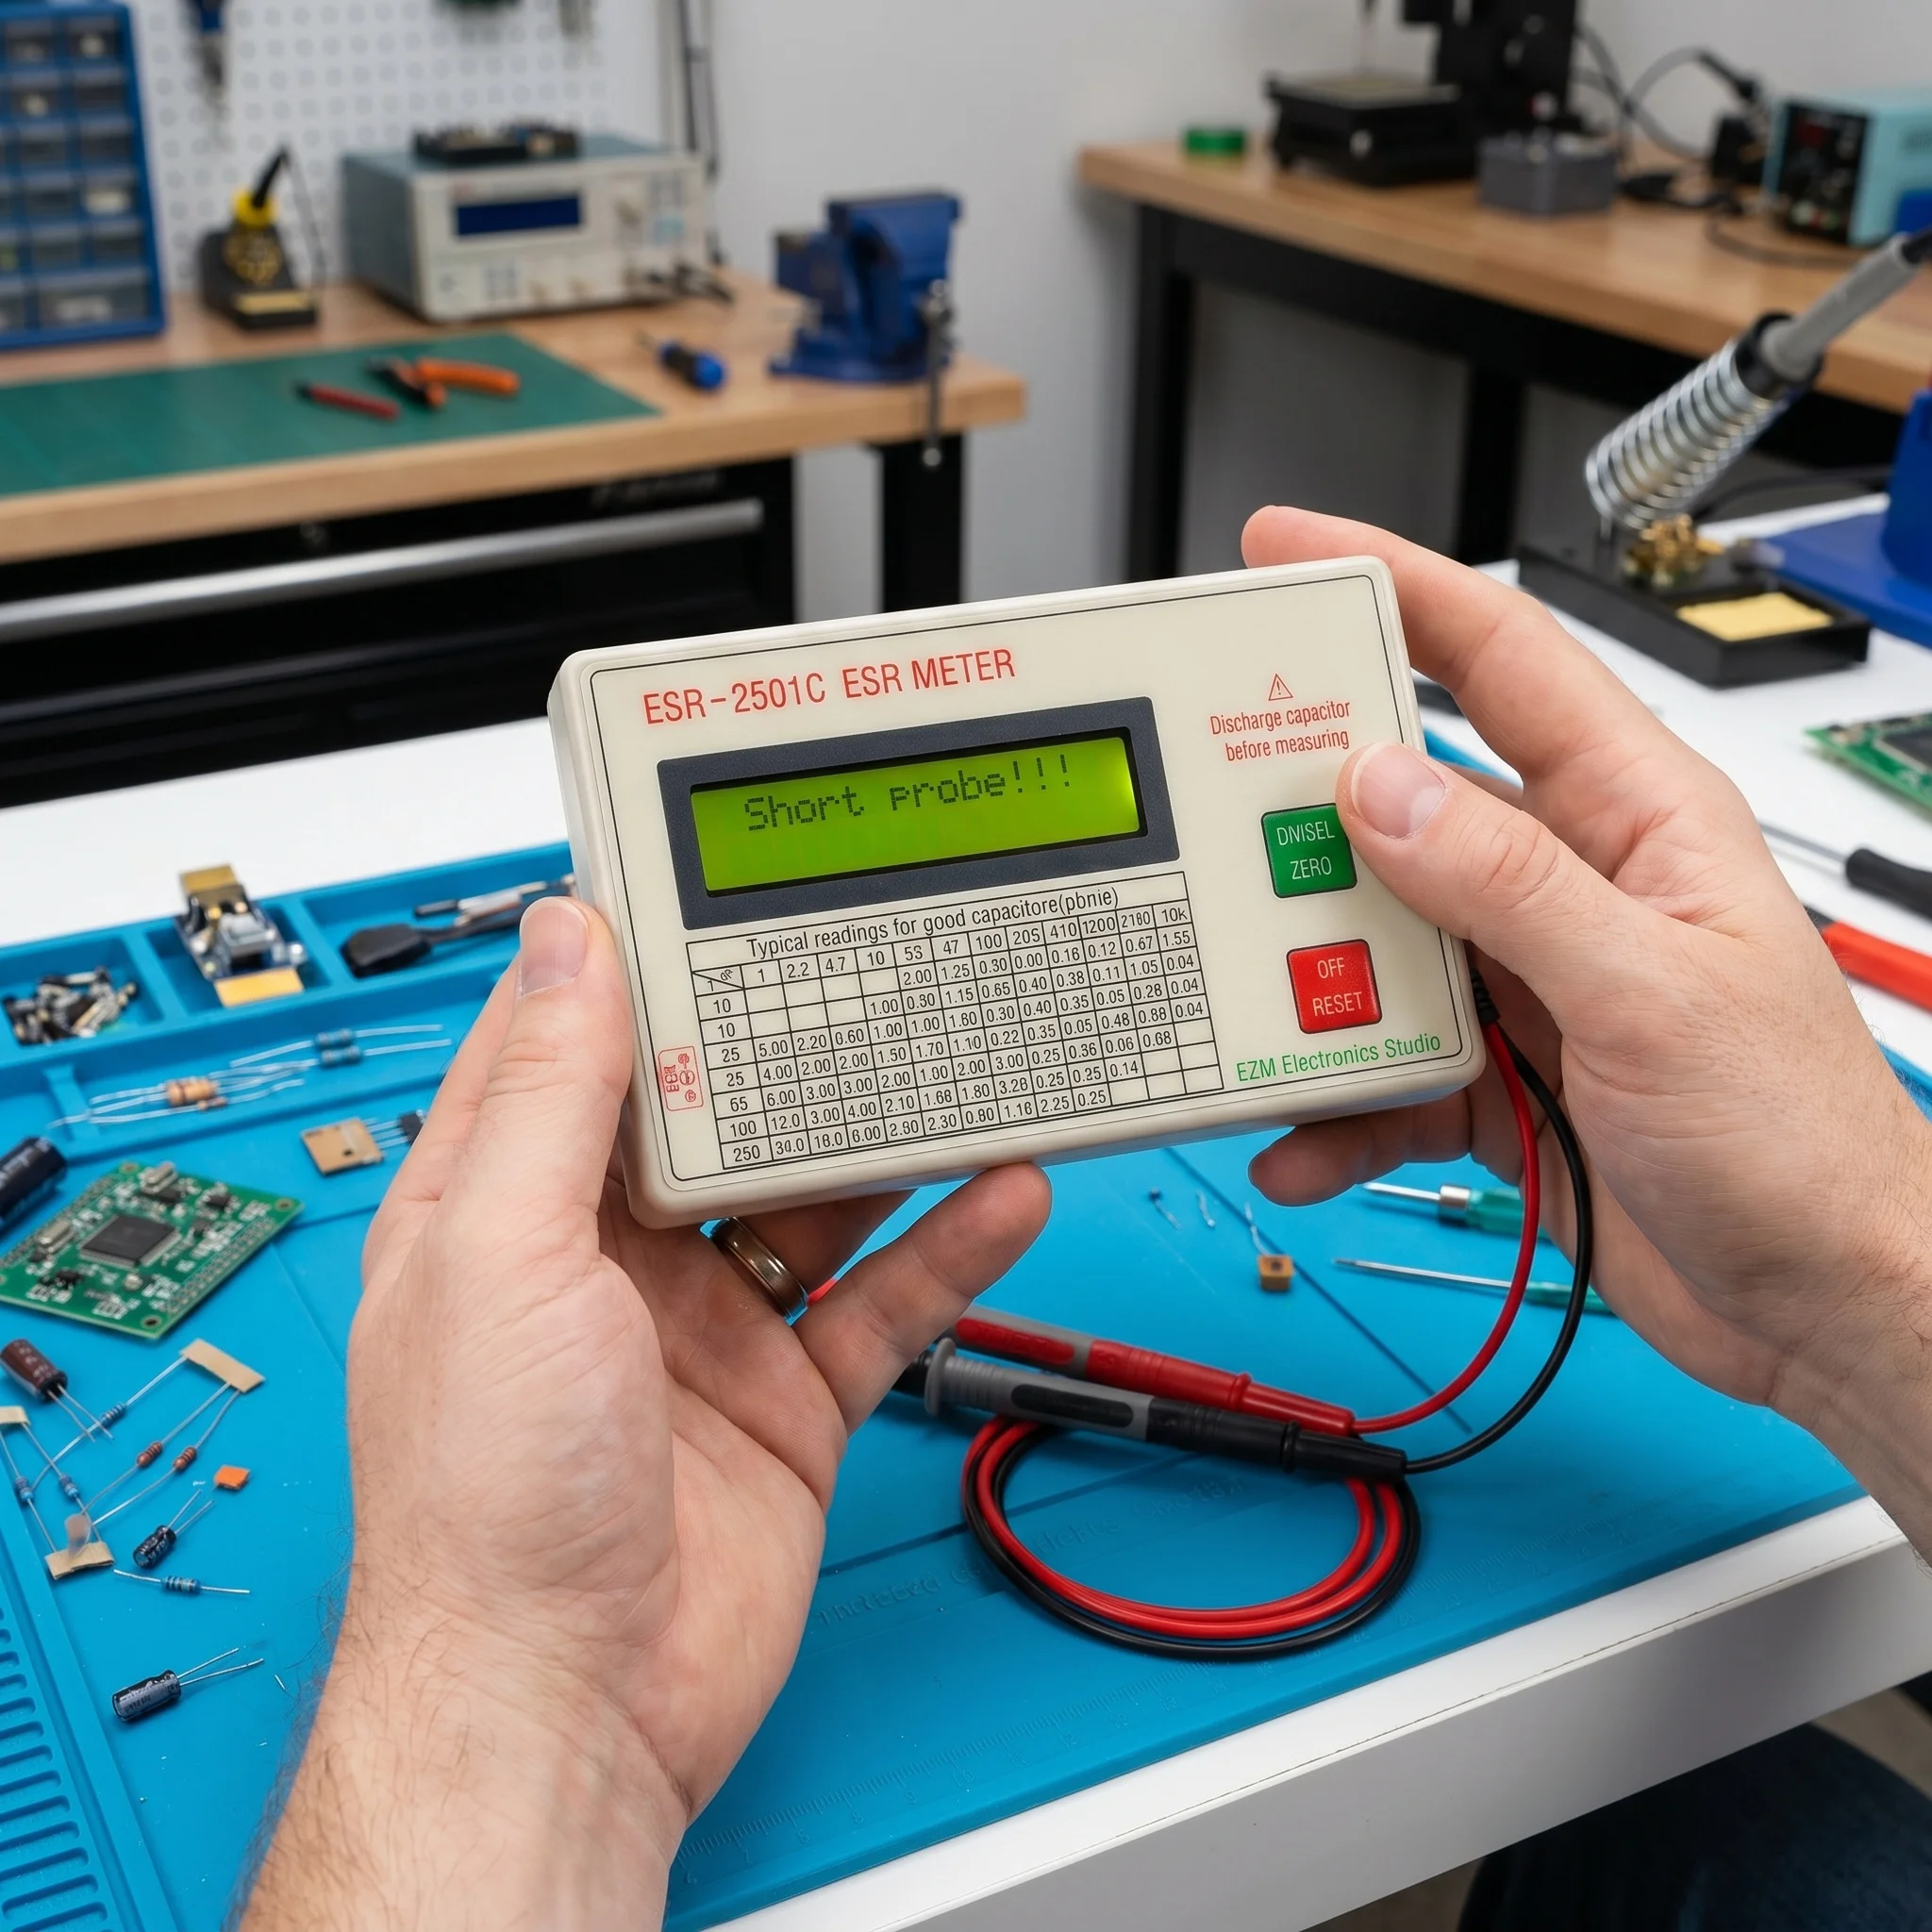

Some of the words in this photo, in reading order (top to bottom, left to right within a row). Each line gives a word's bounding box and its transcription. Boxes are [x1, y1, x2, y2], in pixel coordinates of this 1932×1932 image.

[841, 663, 903, 699] ESR
[910, 648, 1016, 690] METER
[1210, 708, 1282, 735] Discharge
[1286, 700, 1350, 726] capacitor
[1225, 737, 1271, 761] before
[1275, 728, 1350, 753] measuring
[744, 786, 864, 831] Short
[890, 755, 1070, 810] probe!!!
[1290, 856, 1332, 880] ZERO
[745, 931, 808, 960] Typical
[814, 924, 889, 948] readings
[892, 917, 917, 936] for
[923, 908, 966, 937] good
[758, 968, 765, 983] 1
[786, 961, 810, 979] 2.2
[825, 956, 845, 973] 4.7
[867, 950, 885, 967] 10
[942, 939, 958, 955] 47
[975, 933, 1003, 951] 100
[1050, 922, 1077, 939] 410
[1082, 916, 1116, 935] 1200
[713, 998, 731, 1014] 10
[903, 968, 932, 986] 2.00
[941, 963, 971, 980] 1.25
[979, 957, 1008, 974] 0.30
[1014, 952, 1043, 970] 0.00
[1088, 941, 1117, 958] 0.12
[1125, 935, 1153, 953] 0.67
[1162, 930, 1191, 947] 1.55
[717, 1022, 736, 1039] 10
[870, 998, 899, 1015] 1.00
[945, 987, 974, 1005] 1.15
[981, 981, 1011, 999] 0.65
[1018, 975, 1047, 993] 0.40
[1056, 970, 1085, 988] 0.38
[1092, 965, 1120, 982] 0.11
[1130, 959, 1158, 976] 1.05
[1166, 954, 1194, 971] 0.04
[1317, 957, 1345, 979] OFF
[721, 1046, 741, 1063] 25
[758, 1040, 789, 1058] 5.00
[796, 1034, 827, 1052] 2.20
[874, 1022, 903, 1040] 1.00
[911, 1016, 941, 1033] 1.00
[986, 1005, 1015, 1023] 0.30
[1023, 999, 1052, 1017] 0.40
[1059, 994, 1090, 1011] 0.35
[1096, 989, 1125, 1006] 0.05
[1133, 983, 1163, 1000] 0.28
[1171, 977, 1199, 995] 0.04
[1312, 991, 1363, 1017] RESET
[725, 1071, 744, 1088] 25
[763, 1064, 792, 1081] 4.00
[801, 1058, 831, 1076] 2.00
[839, 1052, 869, 1070] 2.00
[915, 1041, 944, 1058] 1.70
[991, 1029, 1020, 1046] 0.22
[1027, 1024, 1057, 1041] 0.35
[1063, 1018, 1092, 1036] 0.05
[1101, 1012, 1130, 1030] 0.48
[1174, 1001, 1204, 1018] 0.04
[729, 1096, 748, 1112] 65
[766, 1089, 796, 1107] 6.00
[843, 1076, 873, 1095] 3.00
[881, 1071, 911, 1089] 2.00
[957, 1058, 986, 1076] 2.00
[995, 1053, 1024, 1071] 3.00
[1031, 1047, 1060, 1065] 0.25
[1068, 1041, 1097, 1059] 0.36
[1237, 1058, 1276, 1082] EZM
[1282, 1046, 1379, 1074] Electronics
[1385, 1033, 1441, 1058] Studio
[729, 1120, 757, 1138] 100
[771, 1113, 800, 1131] 12.0
[810, 1107, 841, 1124] 3.00
[847, 1101, 876, 1119] 4.00
[885, 1094, 915, 1113] 2.10
[961, 1083, 991, 1101] 1.80
[1036, 1071, 1065, 1089] 0.25
[1109, 1059, 1139, 1077] 0.14
[733, 1144, 760, 1162] 250
[927, 1113, 958, 1131] 2.30
[965, 1107, 994, 1124] 0.80
[1040, 1095, 1070, 1113] 2.25
[1077, 1090, 1107, 1107] 0.25
